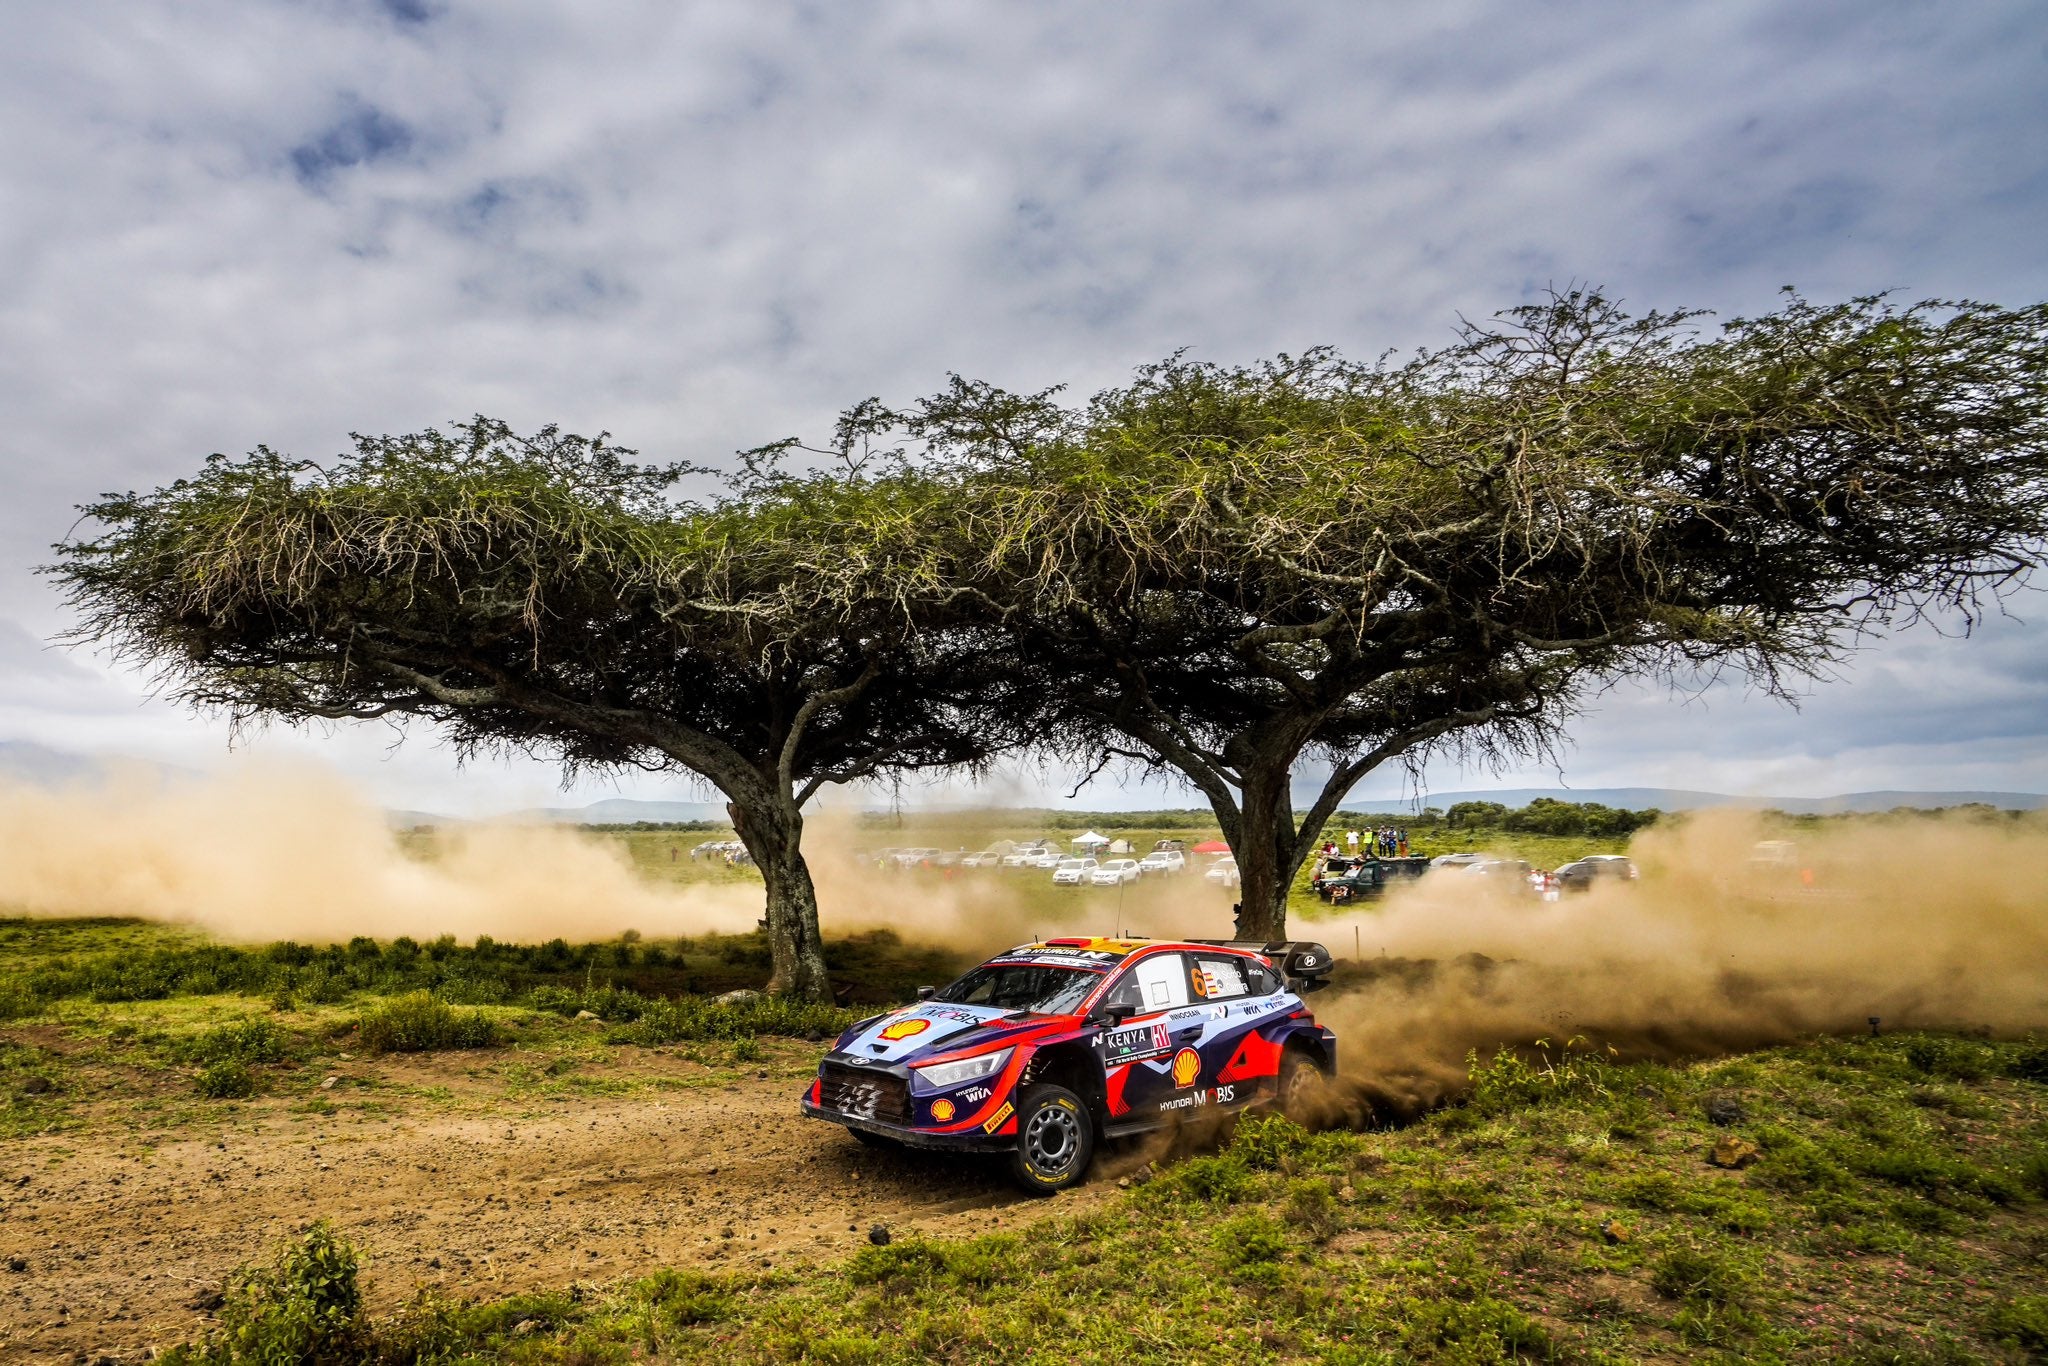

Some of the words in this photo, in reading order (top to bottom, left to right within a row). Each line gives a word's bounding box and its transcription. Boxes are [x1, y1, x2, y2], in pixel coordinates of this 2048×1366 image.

[1031, 948, 1081, 956] HYUNDAI
[1191, 968, 1206, 997] 6
[920, 1009, 987, 1025] MOBIS
[1169, 1010, 1200, 1021] INNOCEAN
[1243, 1005, 1262, 1015] WIA
[1107, 1029, 1146, 1048] KENYA
[1152, 1023, 1169, 1048] HY
[956, 1086, 979, 1097] HYUNDAI
[966, 1088, 992, 1103] WIA
[1160, 1097, 1193, 1112] HYUNDAI
[1194, 1085, 1235, 1108] MOBIS
[986, 1104, 1012, 1131] PIRELLI
